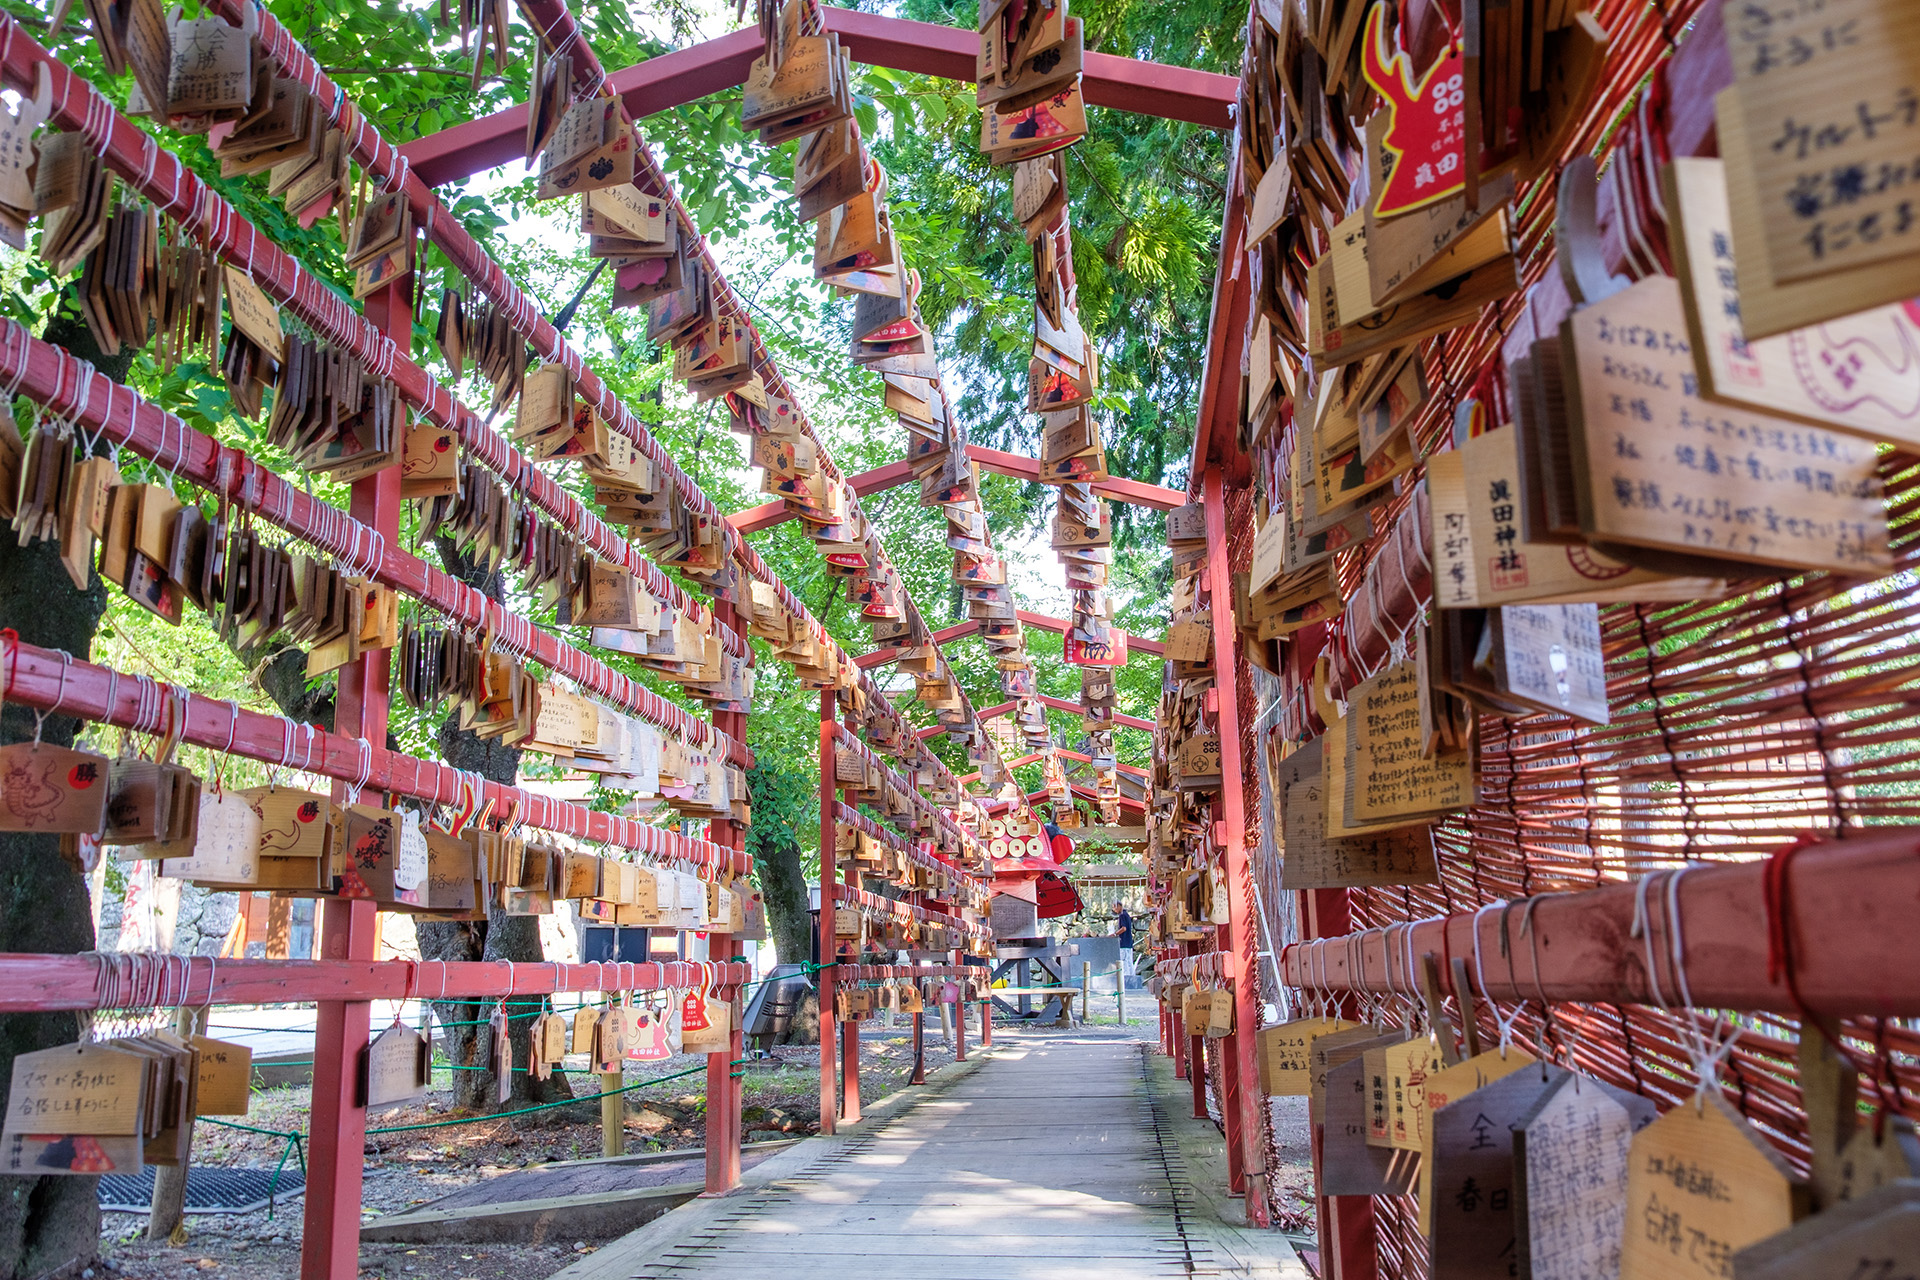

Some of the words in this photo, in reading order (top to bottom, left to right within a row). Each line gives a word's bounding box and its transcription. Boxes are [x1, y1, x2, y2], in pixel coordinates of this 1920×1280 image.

[1753, 19, 1859, 75] ように
[990, 114, 999, 146] 眞田神社
[1325, 285, 1337, 332] 眞田神社
[1602, 355, 1670, 390] おとうさん
[1490, 478, 1522, 572] 眞田神社
[75, 762, 99, 783] 勝
[303, 800, 320, 817] 勝
[1278, 1038, 1305, 1048] みんな
[1280, 1050, 1303, 1060] ように
[1279, 1061, 1309, 1072] 運気上
[18, 1096, 121, 1118] 合格しますように!
[1373, 1074, 1384, 1130] 眞田神社
[1394, 1074, 1406, 1132] 眞田神社
